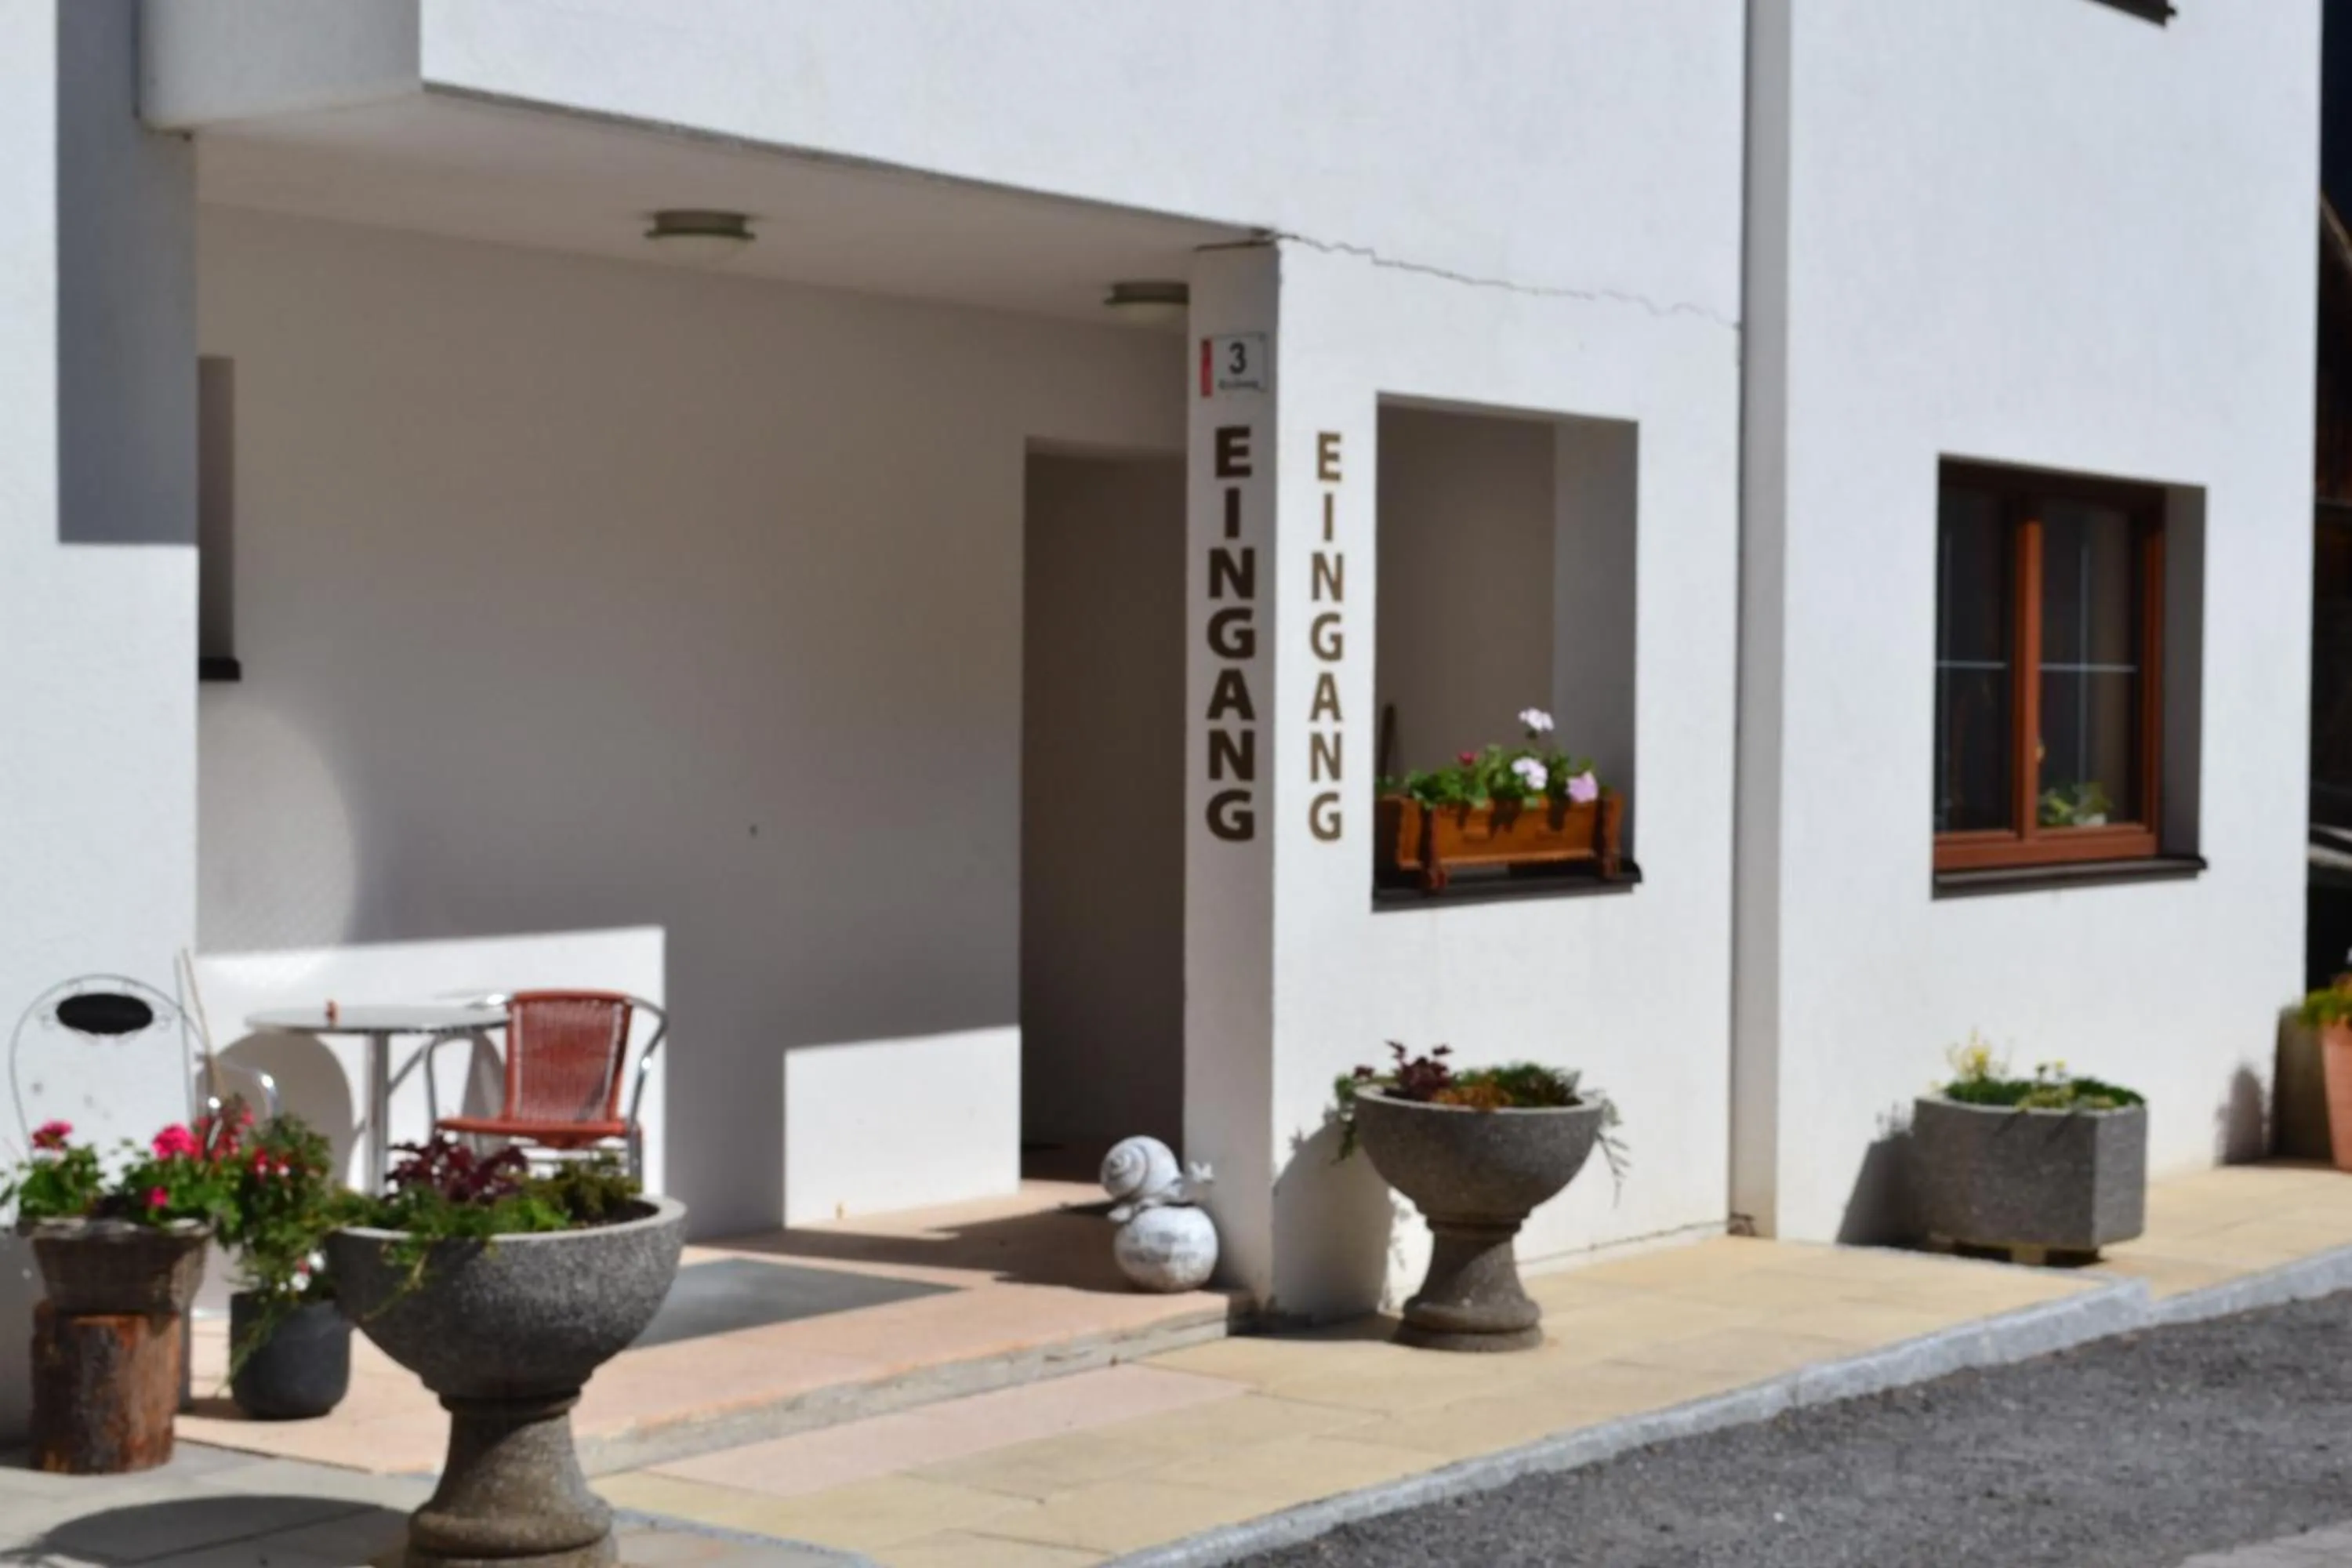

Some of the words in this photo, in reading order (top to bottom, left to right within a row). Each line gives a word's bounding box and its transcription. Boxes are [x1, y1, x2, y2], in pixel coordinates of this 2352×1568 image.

[1229, 341, 1247, 375] 3
[1207, 425, 1256, 842] EINGANG
[1308, 431, 1343, 842] EINGANG
